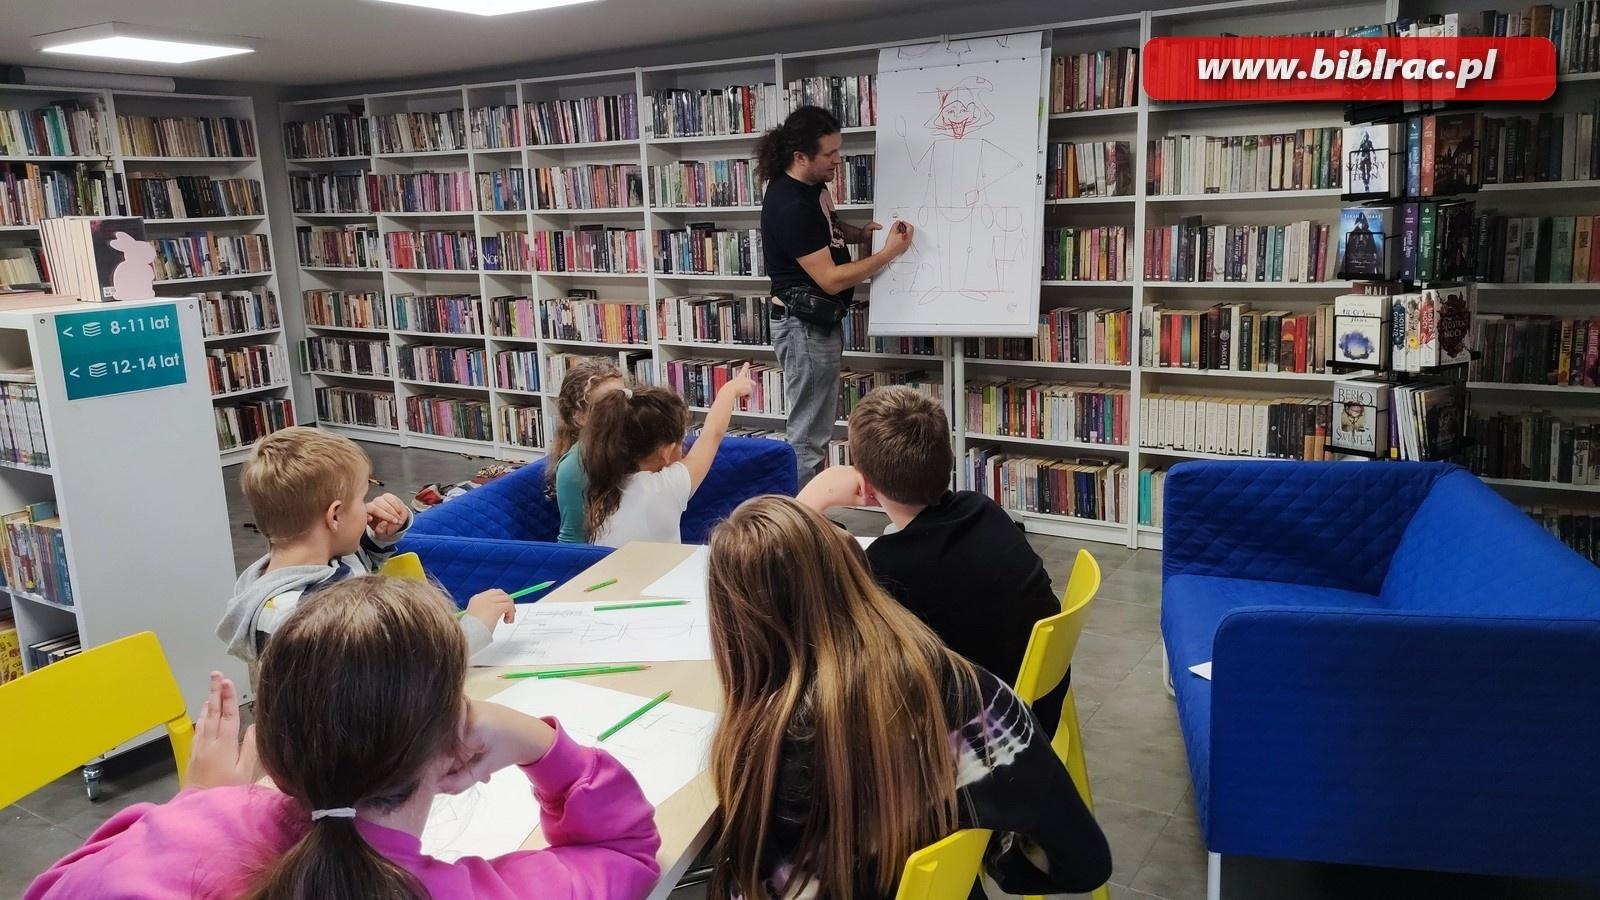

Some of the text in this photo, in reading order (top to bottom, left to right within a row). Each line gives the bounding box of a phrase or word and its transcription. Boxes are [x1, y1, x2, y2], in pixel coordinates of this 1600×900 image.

[110, 315, 170, 335] 8-11 lat
[112, 353, 180, 375] 12-14 lat
